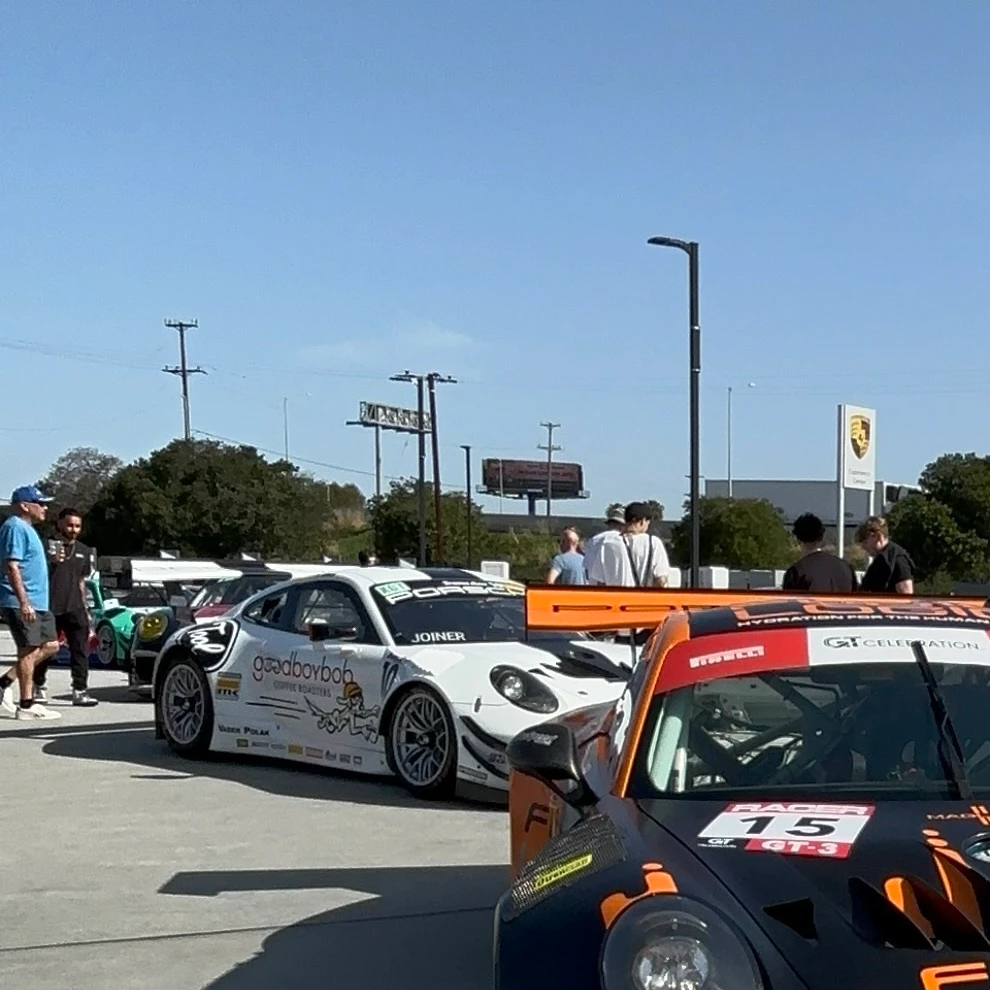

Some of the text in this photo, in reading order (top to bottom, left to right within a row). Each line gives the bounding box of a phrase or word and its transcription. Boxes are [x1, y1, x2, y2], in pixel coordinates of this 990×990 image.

[385, 584, 525, 605] PORSCH
[737, 615, 844, 627] HYDRATION
[411, 631, 466, 643] JOINER
[690, 645, 765, 668] PIRELLI
[740, 816, 840, 837] 15
[760, 840, 839, 855] GT-3
